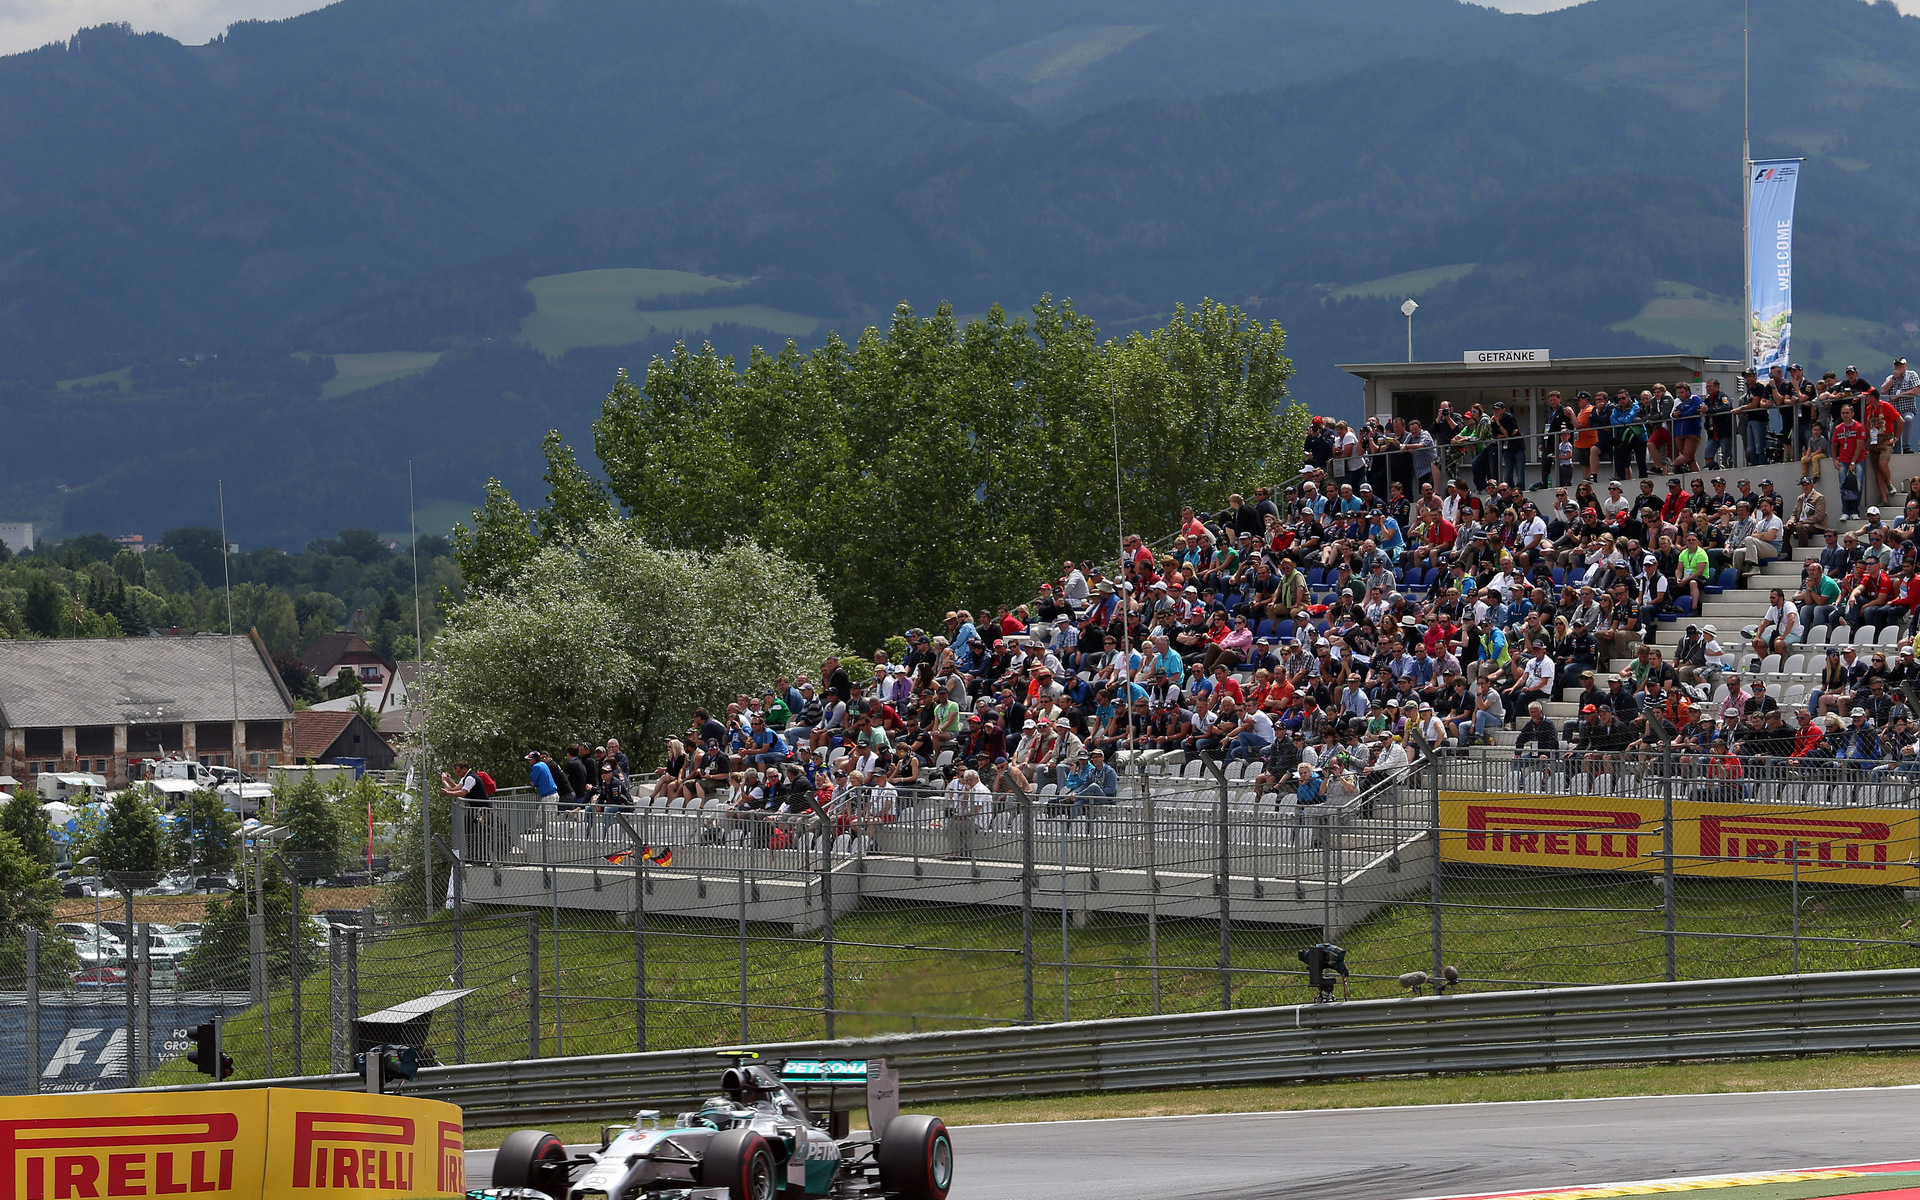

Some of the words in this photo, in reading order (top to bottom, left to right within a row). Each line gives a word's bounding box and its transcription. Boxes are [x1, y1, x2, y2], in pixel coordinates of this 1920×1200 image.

[1755, 168, 1777, 180] F1
[1777, 219, 1791, 291] WELCOME
[1478, 351, 1535, 361] GETRÄNKE
[1467, 806, 1641, 858] PIRELLI
[1700, 815, 1890, 870] PIRELLI
[173, 1029, 188, 1038] FO
[784, 1062, 867, 1073] PETRONA
[40, 1081, 86, 1090] ormula
[0, 1113, 239, 1200] PIRELLI
[292, 1112, 415, 1191] PIRELLI
